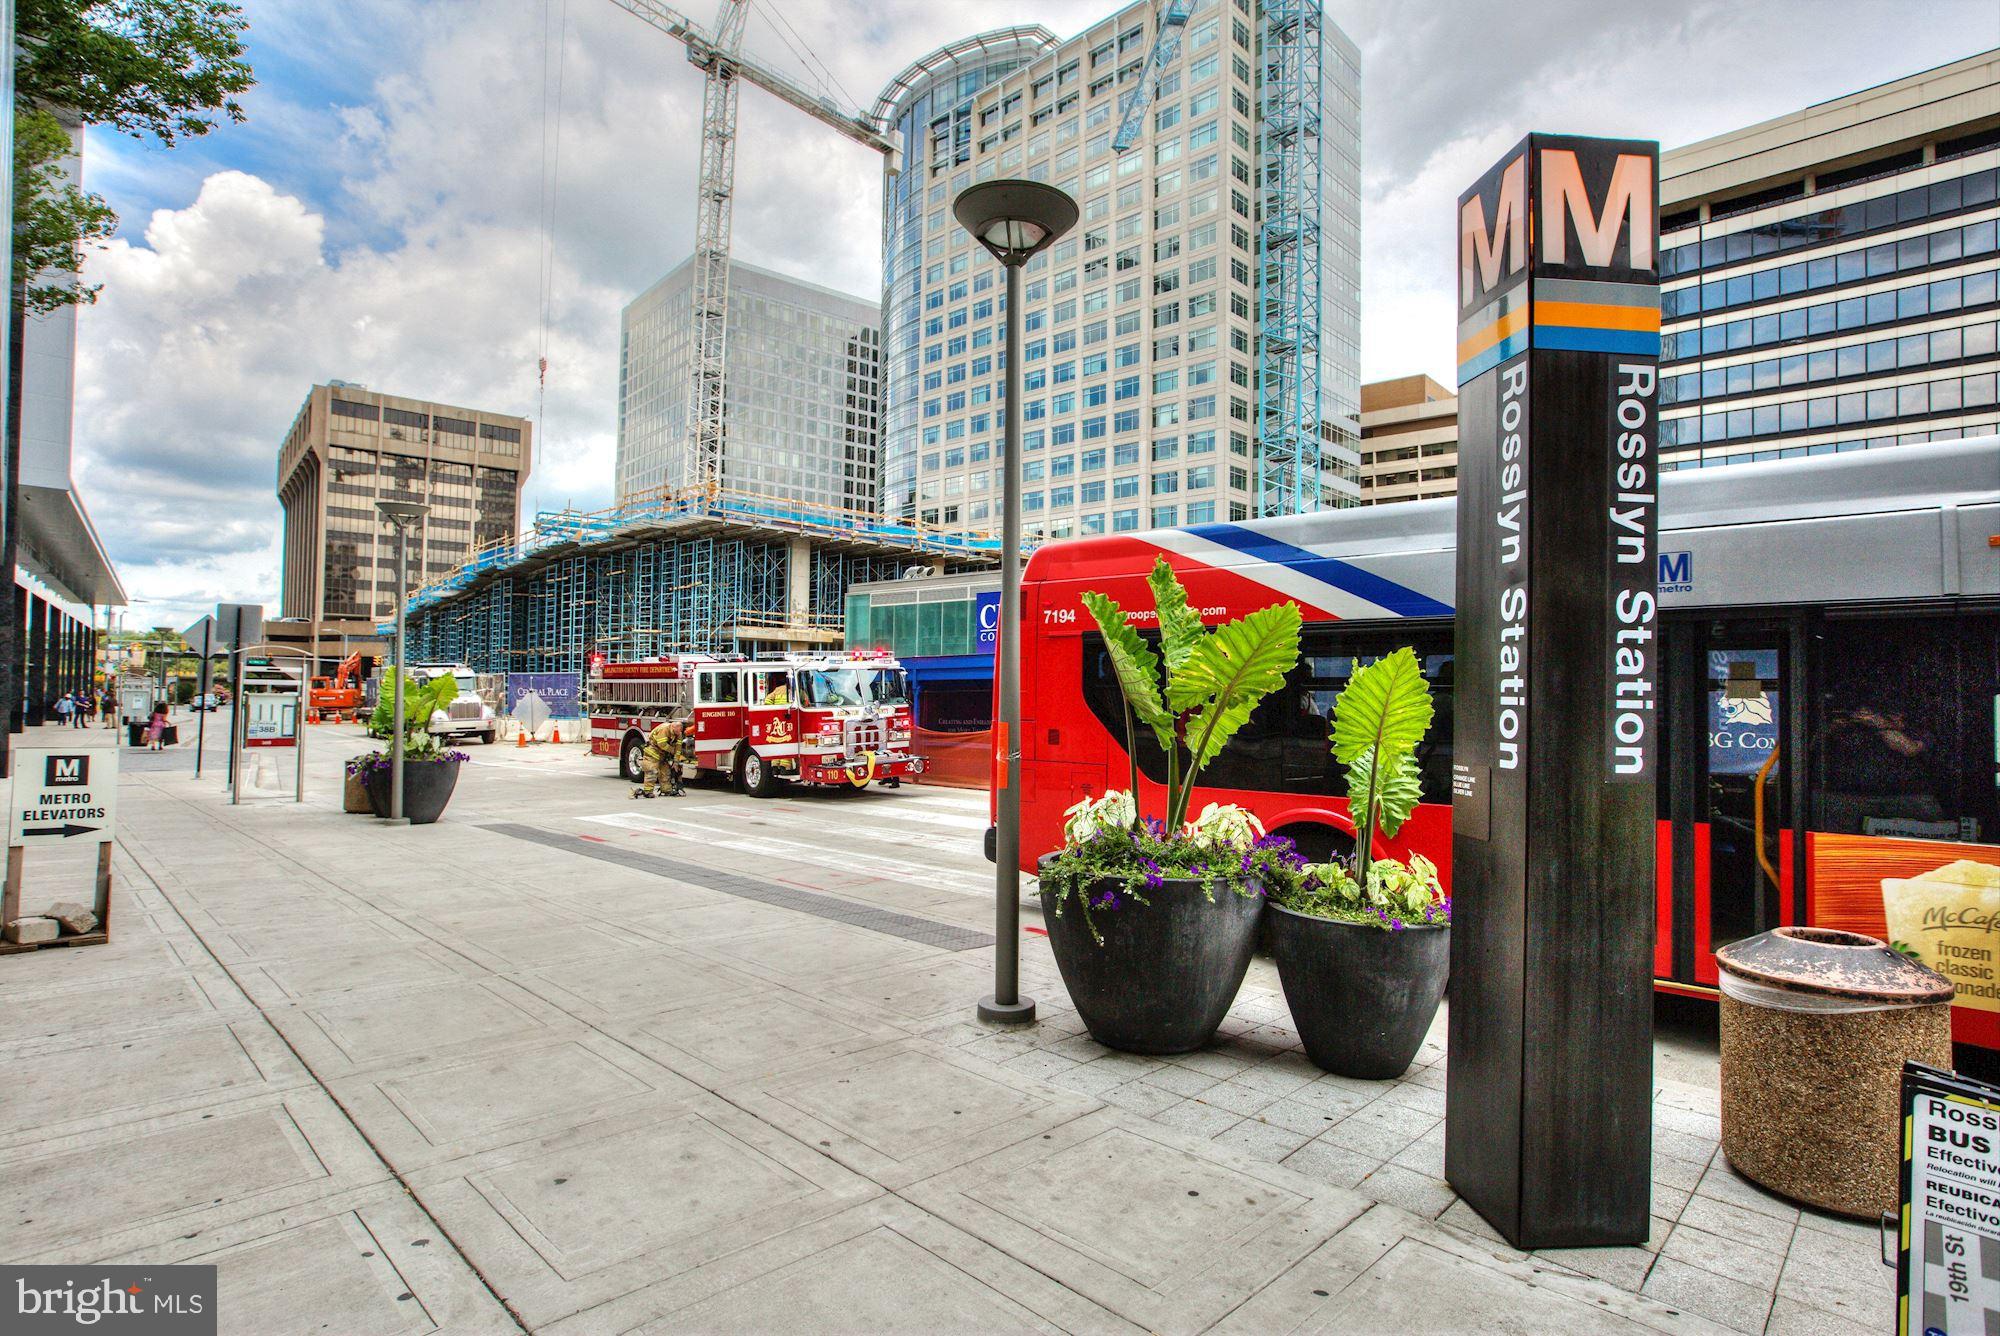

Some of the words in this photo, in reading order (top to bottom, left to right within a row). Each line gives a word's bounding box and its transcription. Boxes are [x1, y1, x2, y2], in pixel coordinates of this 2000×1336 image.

[1541, 149, 1653, 271] M
[1461, 153, 1525, 310] M
[1497, 361, 1527, 564] Rosslyn
[1609, 363, 1656, 564] Rosslyn
[1043, 609, 1075, 624] 7194
[650, 665, 675, 673] DEPARTMEN
[1499, 588, 1527, 770] Station
[1614, 589, 1656, 774] Station
[547, 687, 569, 697] PLACE
[599, 741, 609, 752] 110
[55, 758, 79, 776] M
[827, 769, 839, 780] 110
[39, 793, 91, 805] METRO
[22, 807, 105, 821] ELEVATORS
[1937, 940, 1991, 961] frozen
[1935, 959, 1994, 980] classic
[1929, 1099, 2000, 1131] Ross
[1928, 1124, 1991, 1154] BUS
[1927, 1145, 2000, 1175] Effectiv
[1926, 1162, 1977, 1181] Relocation
[1979, 1177, 1996, 1187] will
[1926, 1195, 2000, 1226] Efectivo
[1945, 1234, 1965, 1256] St
[1947, 1262, 1970, 1303] 19th
